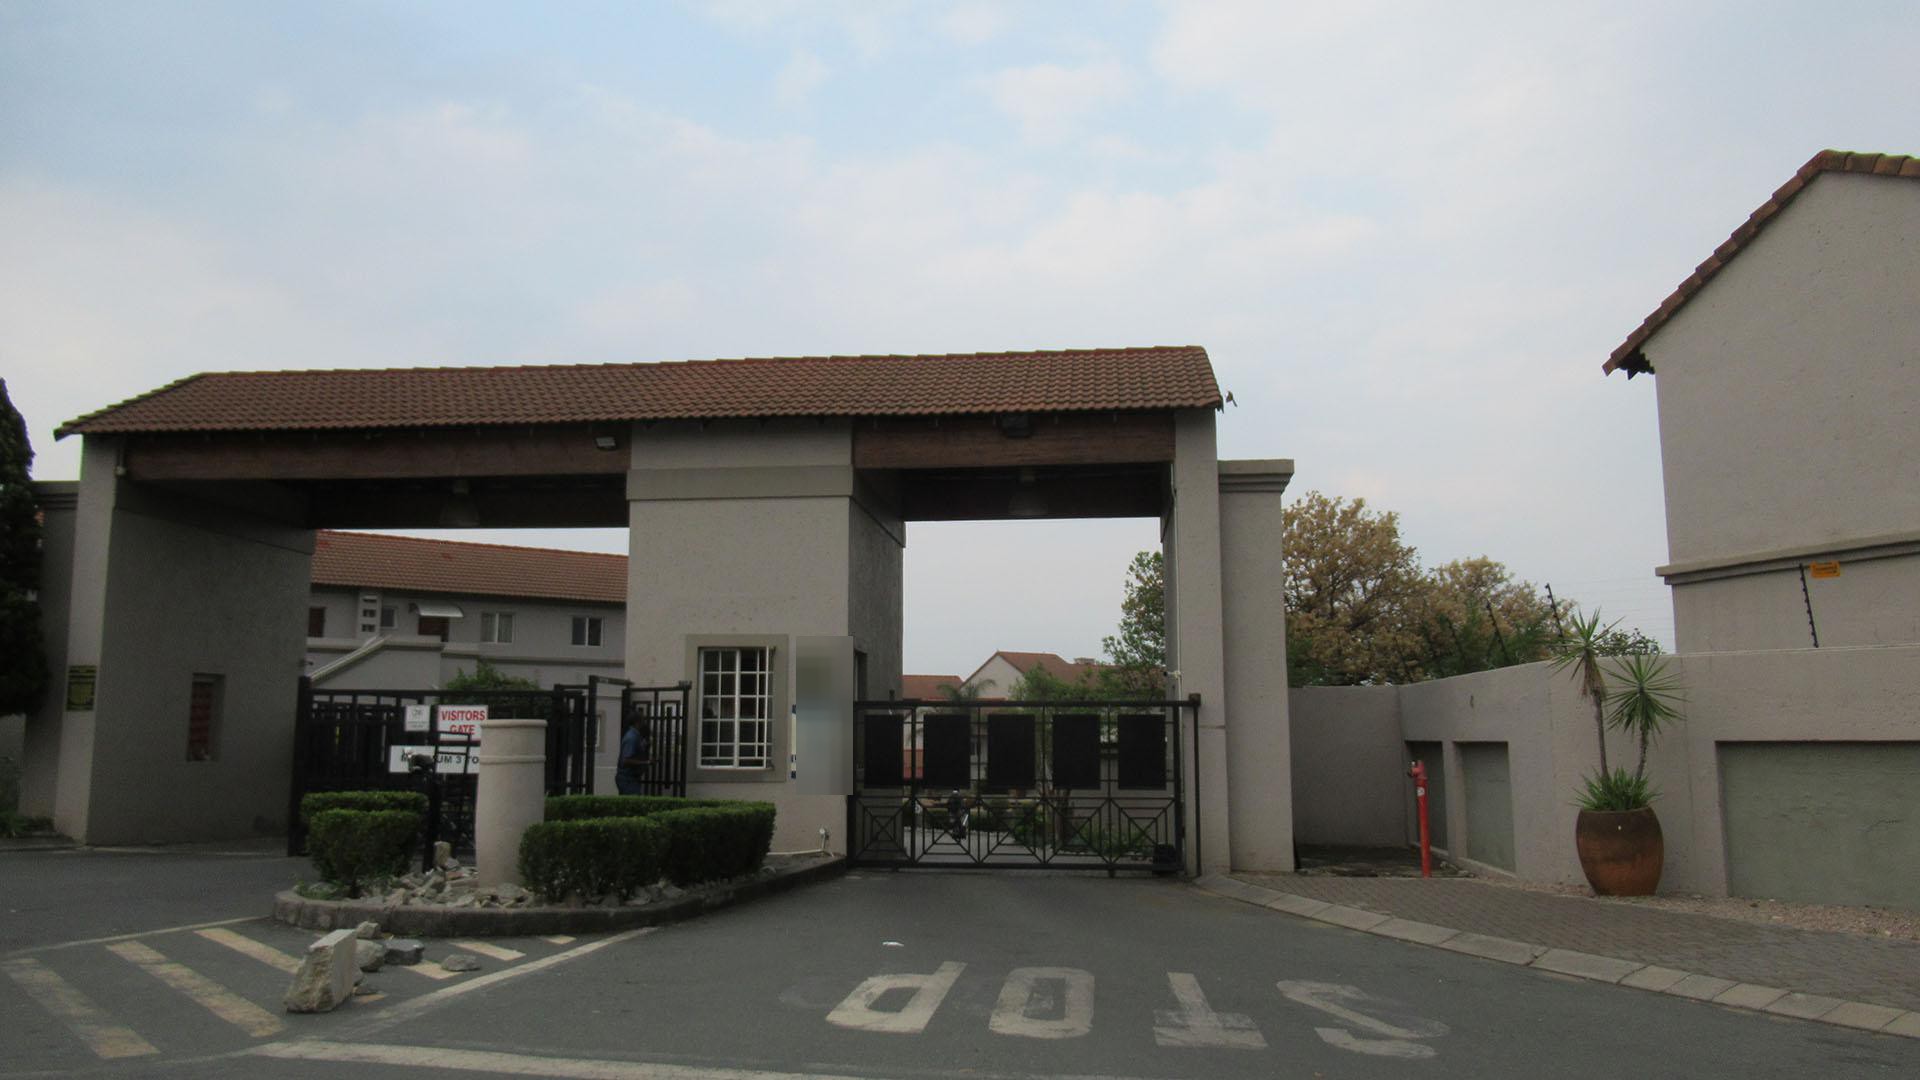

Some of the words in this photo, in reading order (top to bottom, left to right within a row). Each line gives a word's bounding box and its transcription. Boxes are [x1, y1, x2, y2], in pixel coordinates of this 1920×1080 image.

[441, 710, 486, 722] VISITORS
[449, 724, 475, 735] GATE
[825, 961, 1450, 1059] STOP
